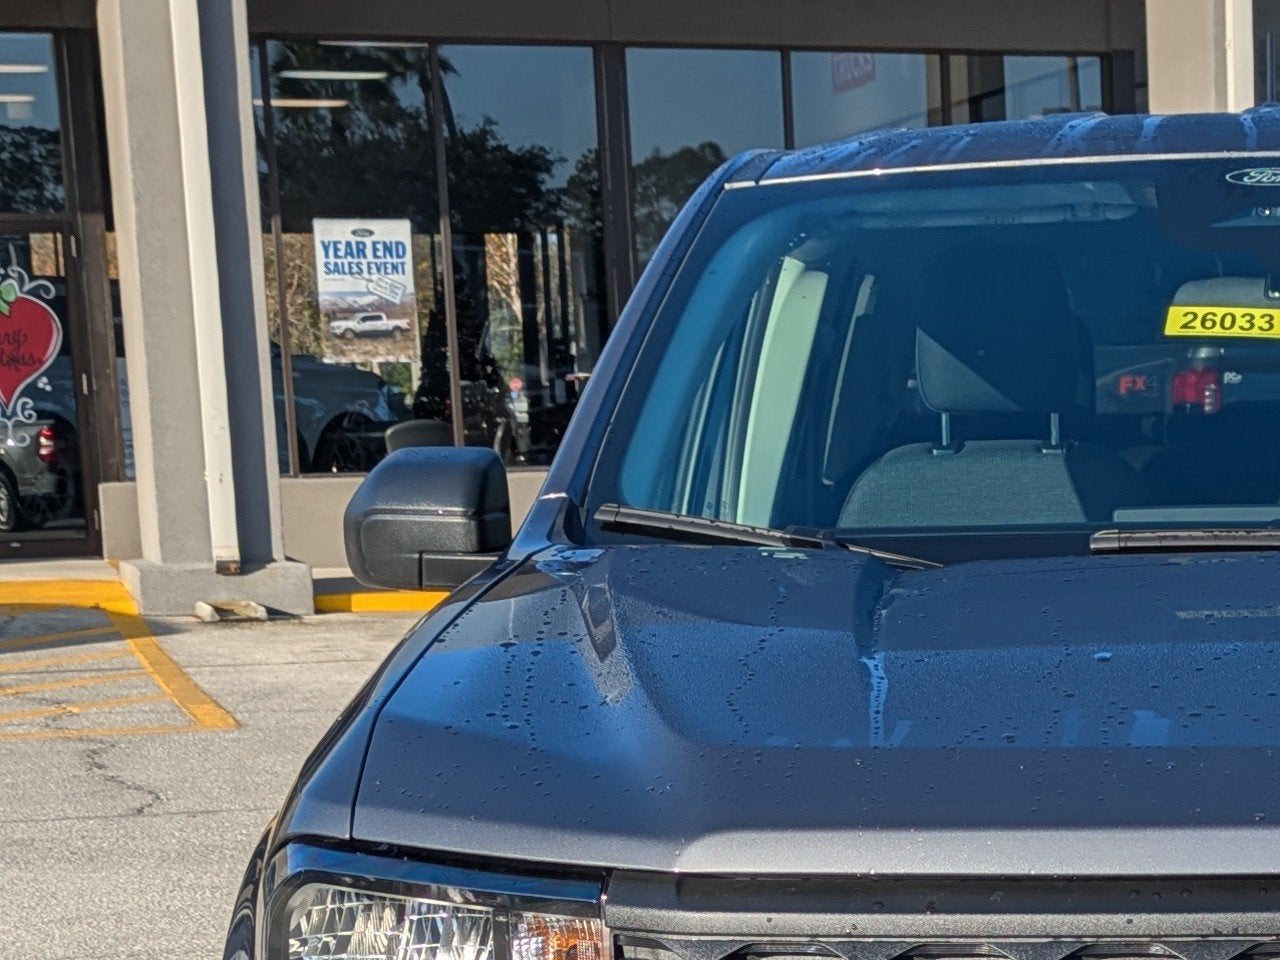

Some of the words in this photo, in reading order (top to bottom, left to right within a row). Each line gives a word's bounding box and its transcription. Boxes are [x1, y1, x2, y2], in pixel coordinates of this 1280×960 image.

[320, 240, 368, 259] YEAR
[372, 241, 407, 259] END
[324, 261, 364, 275] SALES
[367, 262, 406, 276] EVENT
[1179, 311, 1275, 332] 26033
